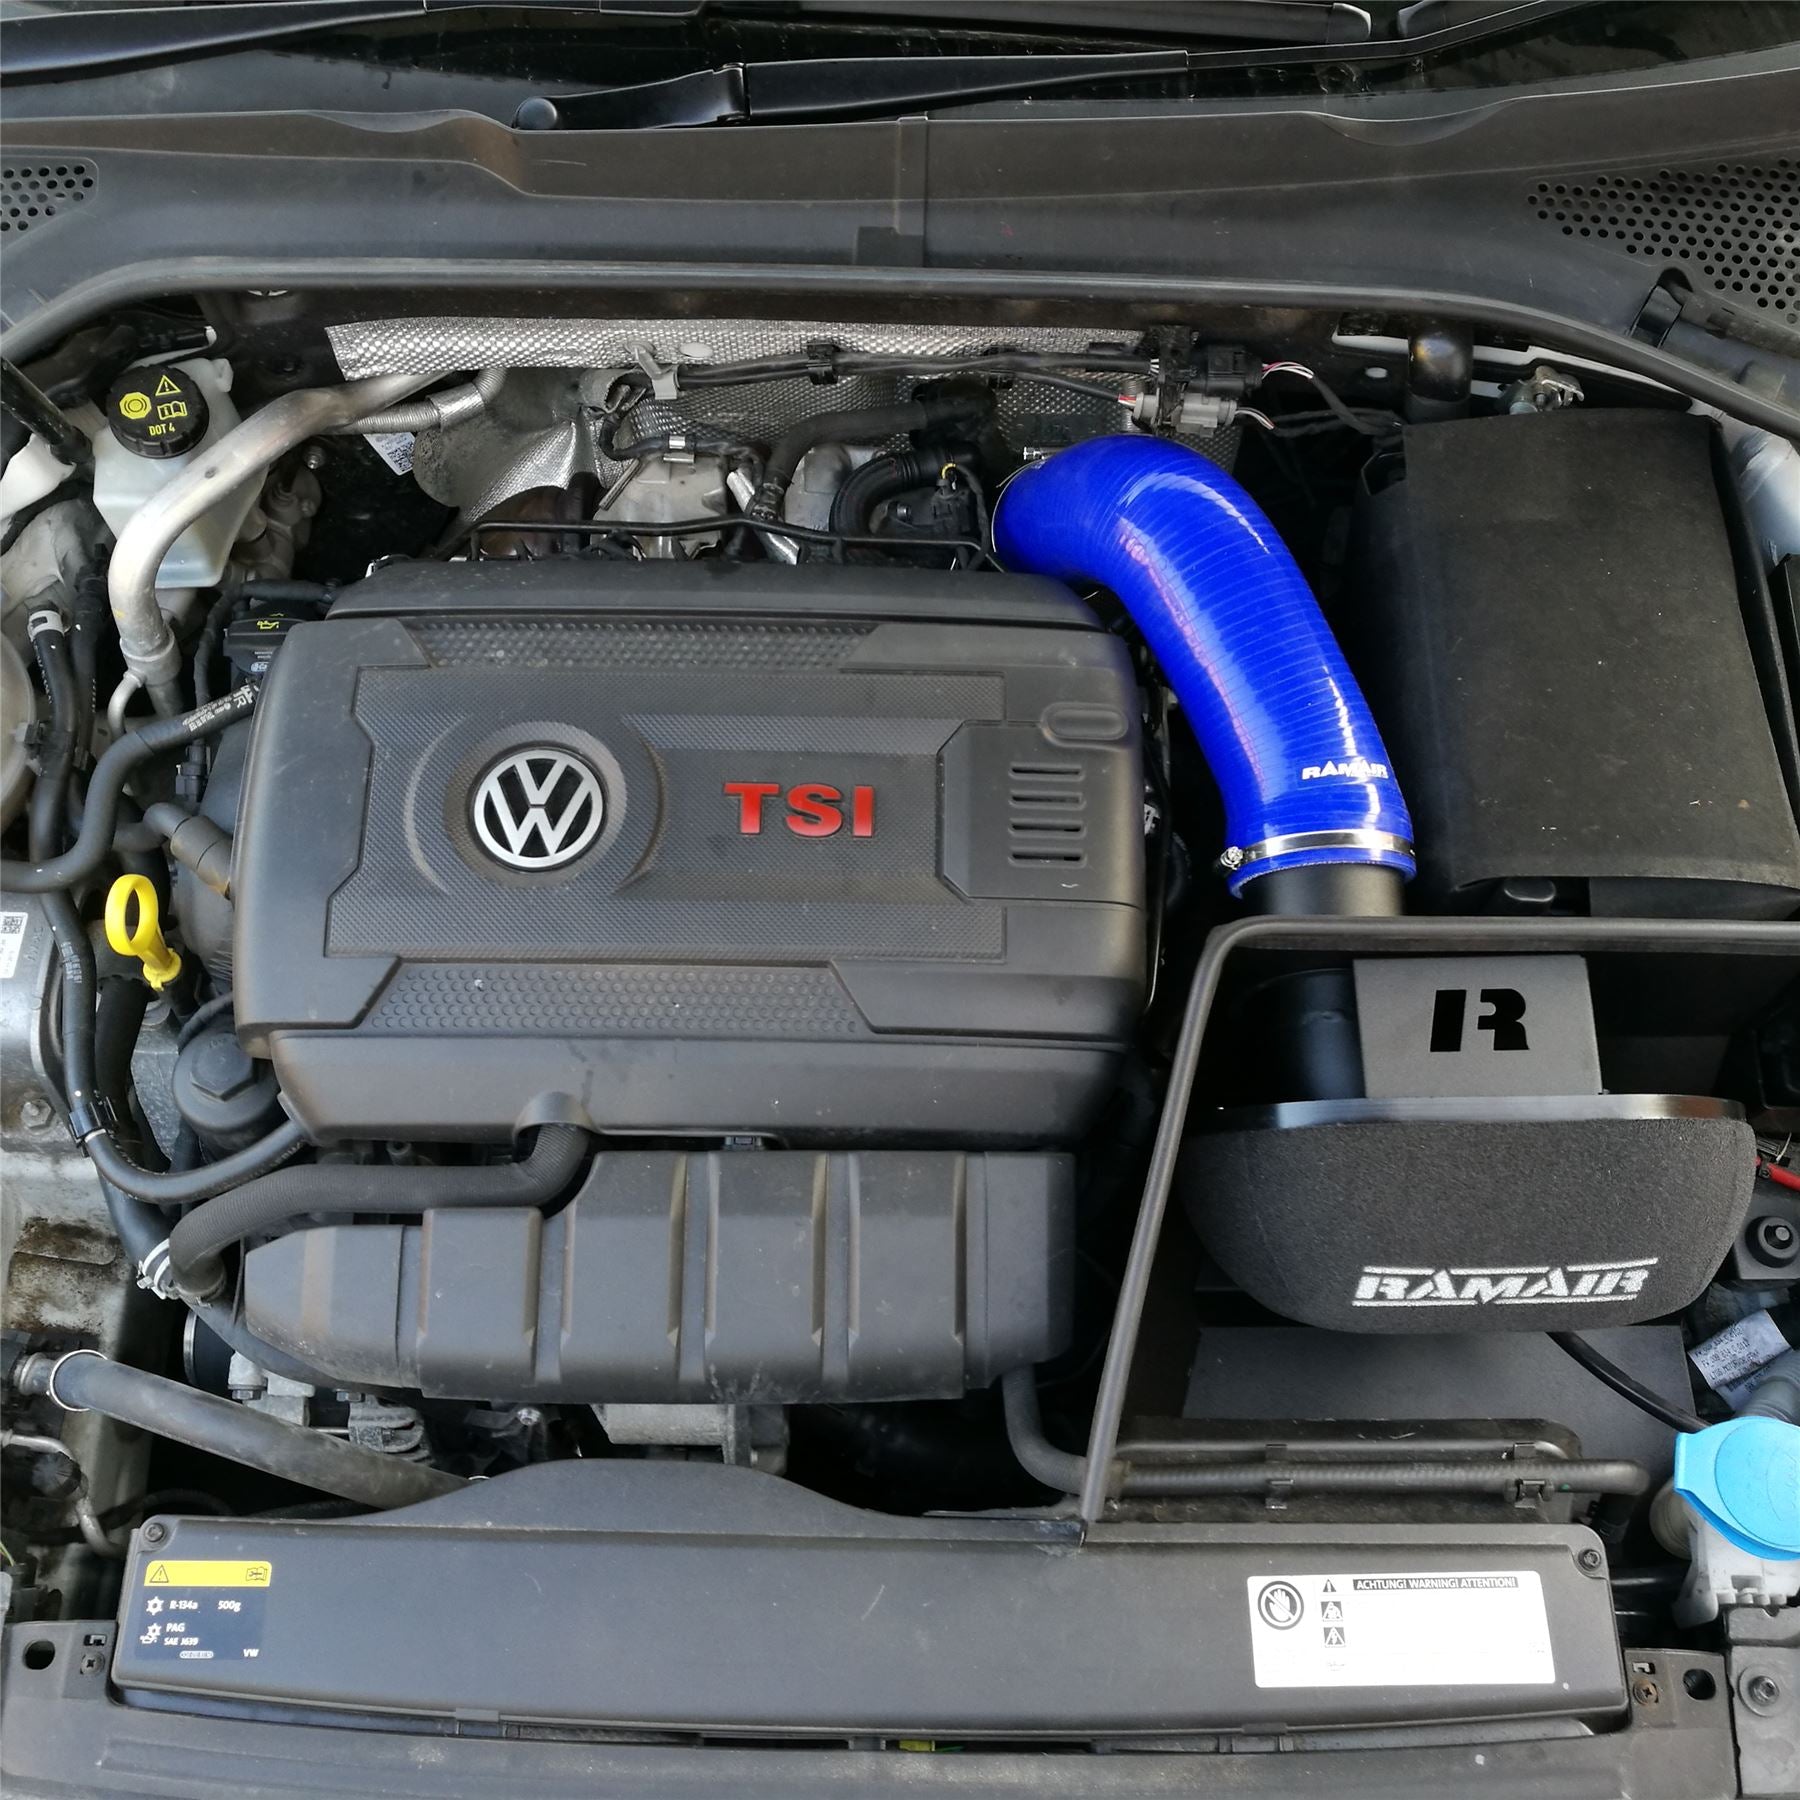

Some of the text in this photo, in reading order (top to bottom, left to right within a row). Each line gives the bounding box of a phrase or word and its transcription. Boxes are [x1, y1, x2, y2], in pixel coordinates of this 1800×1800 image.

[148, 422, 176, 436] DOT 4
[1301, 759, 1389, 780] RAMAIR
[474, 749, 603, 869] VW
[723, 782, 875, 838] TSI
[1429, 988, 1531, 1052] R
[1352, 1263, 1652, 1306] RAMAIR
[1356, 1576, 1517, 1590] ACHTUNG! WARNING! ATTENTION!
[169, 1600, 242, 1613] R-134a 500g
[165, 1622, 186, 1633] PAG
[163, 1637, 179, 1646] SAE
[242, 1649, 260, 1658] VW
